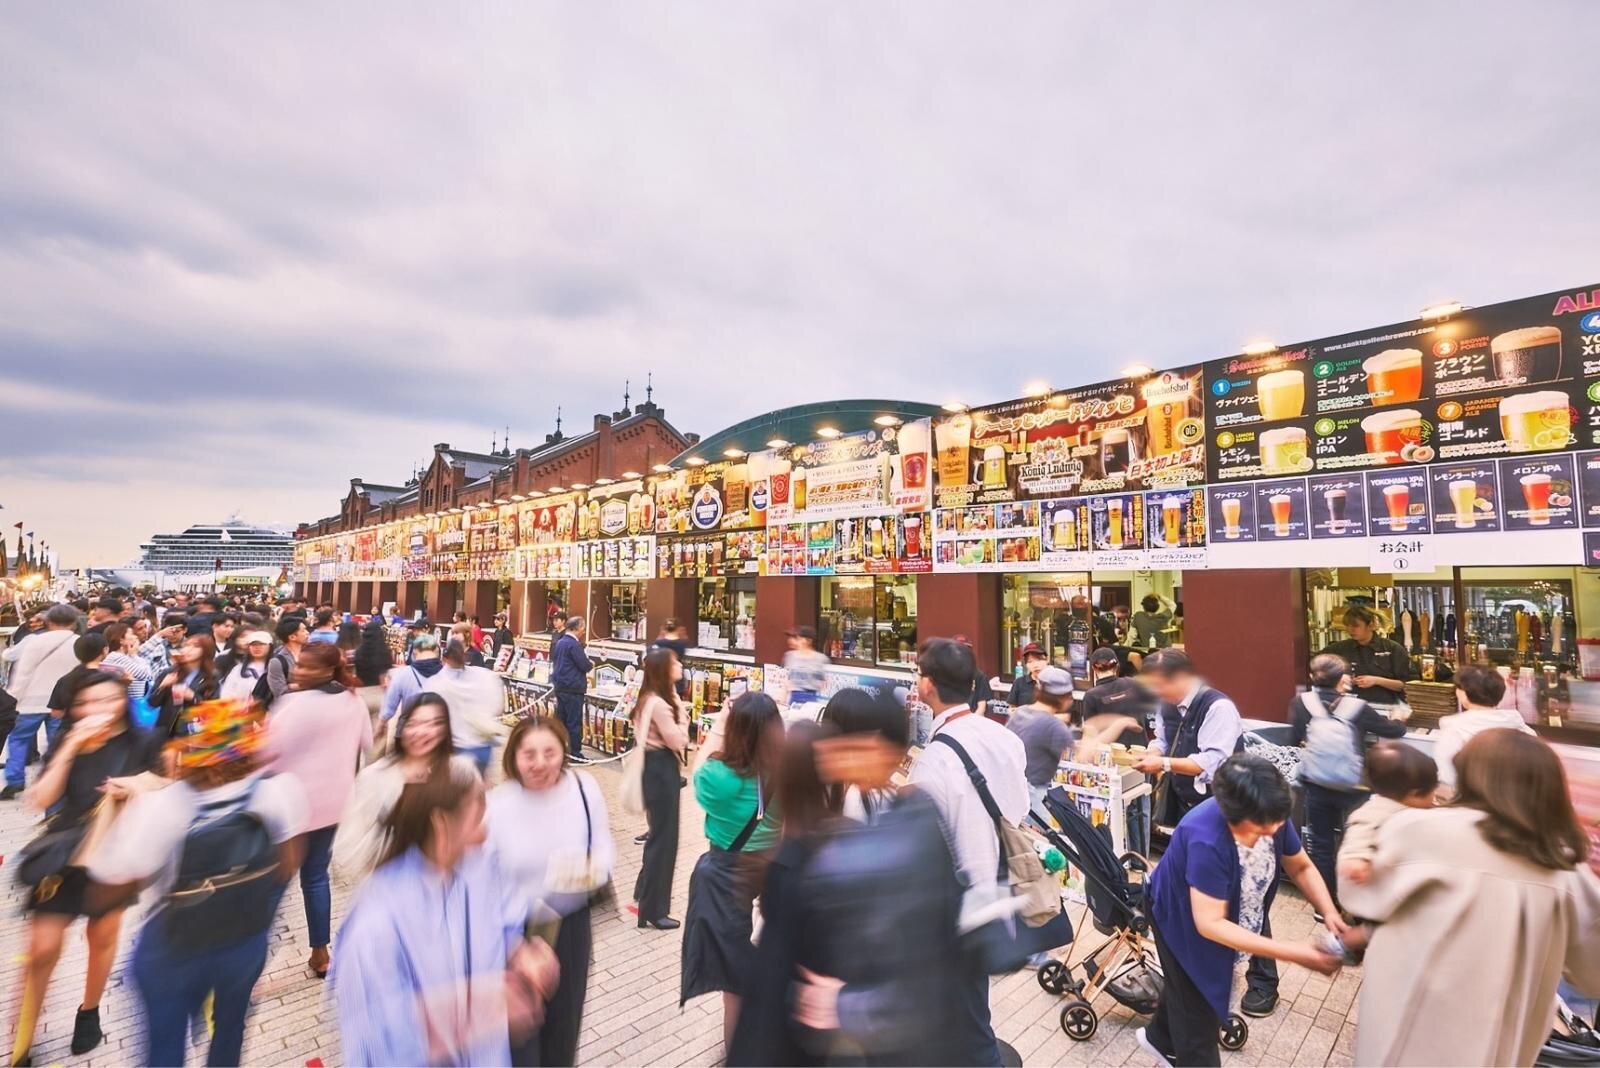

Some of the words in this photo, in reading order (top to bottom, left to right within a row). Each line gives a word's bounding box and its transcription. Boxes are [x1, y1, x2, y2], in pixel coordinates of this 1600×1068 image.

[1434, 355, 1485, 370] ブラウン
[1435, 365, 1486, 379] ポーター
[1317, 372, 1370, 388] ゴールデン
[1317, 385, 1349, 397] エール
[1464, 402, 1498, 412] ORANGE
[1438, 421, 1464, 432] 湘南
[1316, 435, 1348, 446] メロン
[1219, 447, 1247, 457] レモン
[1316, 445, 1336, 455] IPA
[1219, 453, 1260, 465] ラードラー
[1047, 461, 1082, 475] Ludwig
[1513, 465, 1540, 475] メロン
[1542, 464, 1562, 473] IPA
[1370, 477, 1408, 486] YOKOHAMA
[1409, 475, 1424, 484] XPA
[1433, 471, 1493, 481] レモンラードラー
[1259, 486, 1304, 496] ゴールデンエール
[1312, 482, 1361, 491] ブラウンポーター
[1214, 490, 1249, 499] ヴァイツェン
[1379, 541, 1424, 553] お会計
